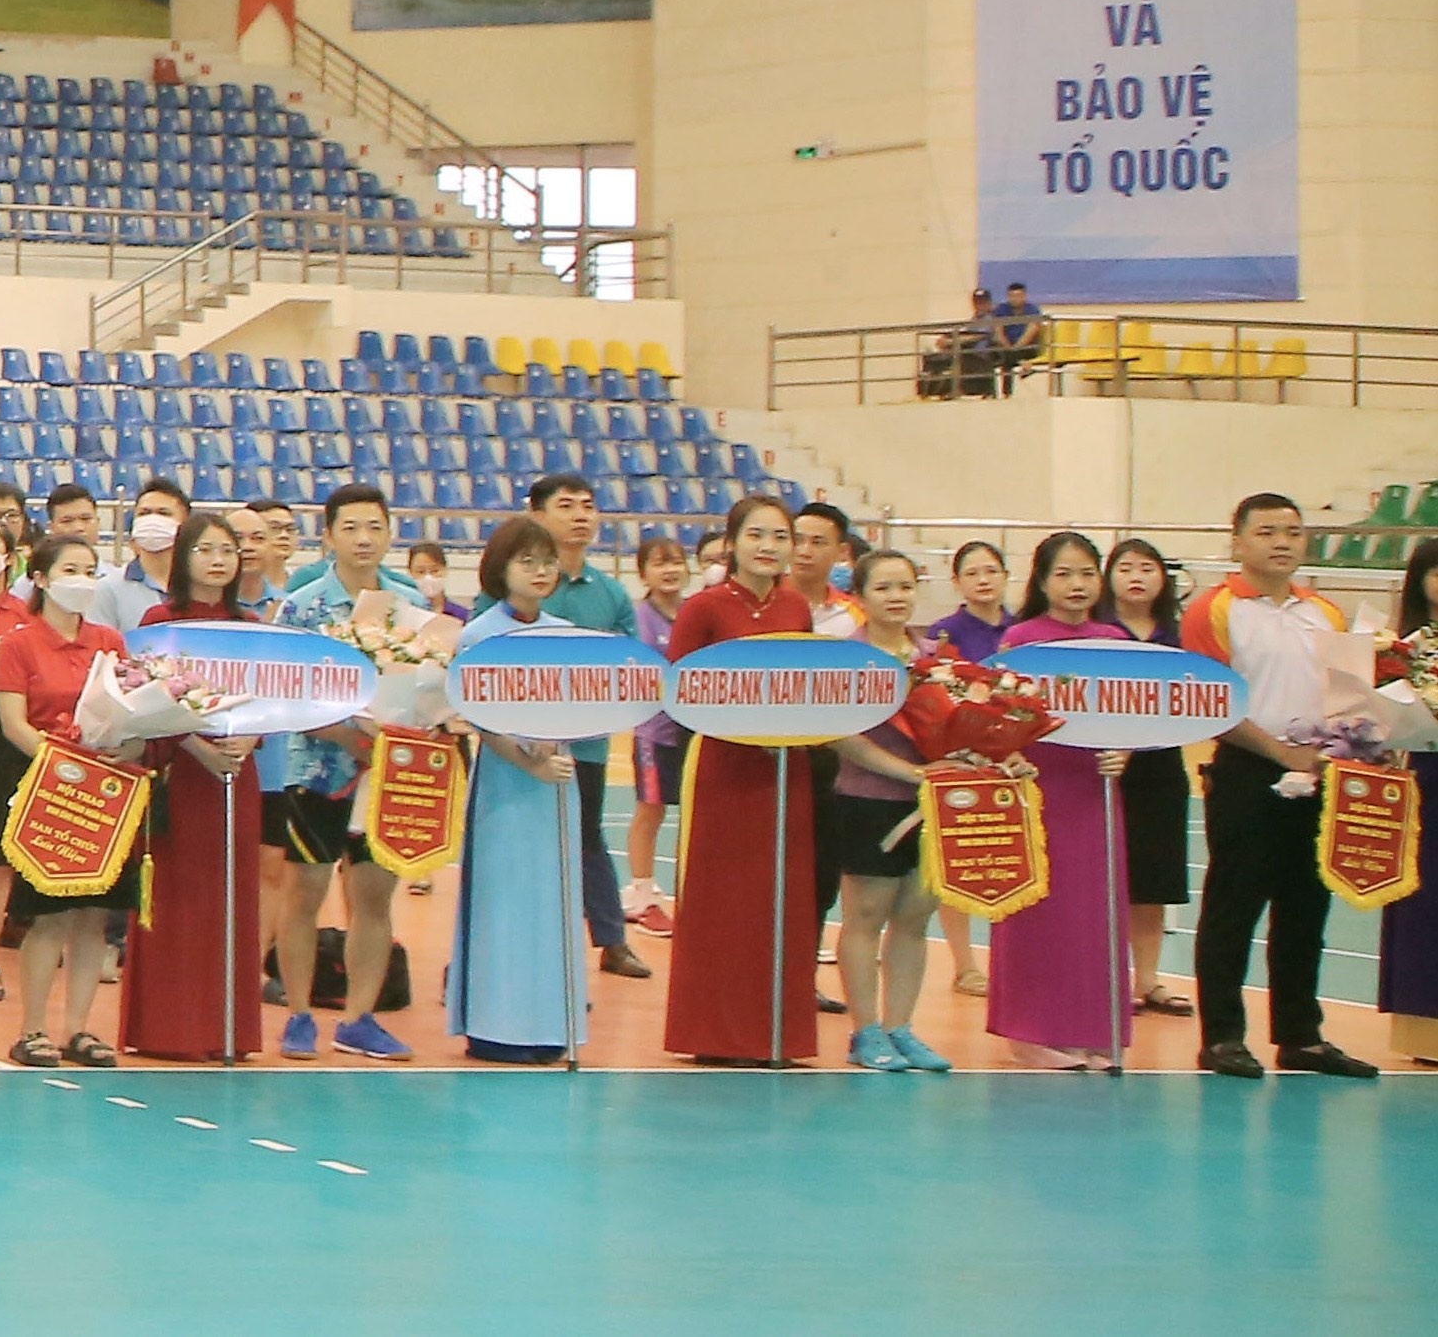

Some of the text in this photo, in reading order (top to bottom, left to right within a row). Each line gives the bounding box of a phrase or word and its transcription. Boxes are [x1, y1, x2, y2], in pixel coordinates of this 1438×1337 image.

[1056, 63, 1213, 129] BẢO VỆ
[1039, 127, 1230, 197] TỔ QUỐC
[255, 665, 304, 699] NINH
[310, 657, 360, 701] BÌNH
[461, 658, 661, 701] VIETINBANK NINH BÌNH
[677, 663, 896, 704] AGRIBANK NAM NINH BÌNH
[1097, 679, 1160, 715] NINH
[1169, 673, 1230, 718] BÌNH
